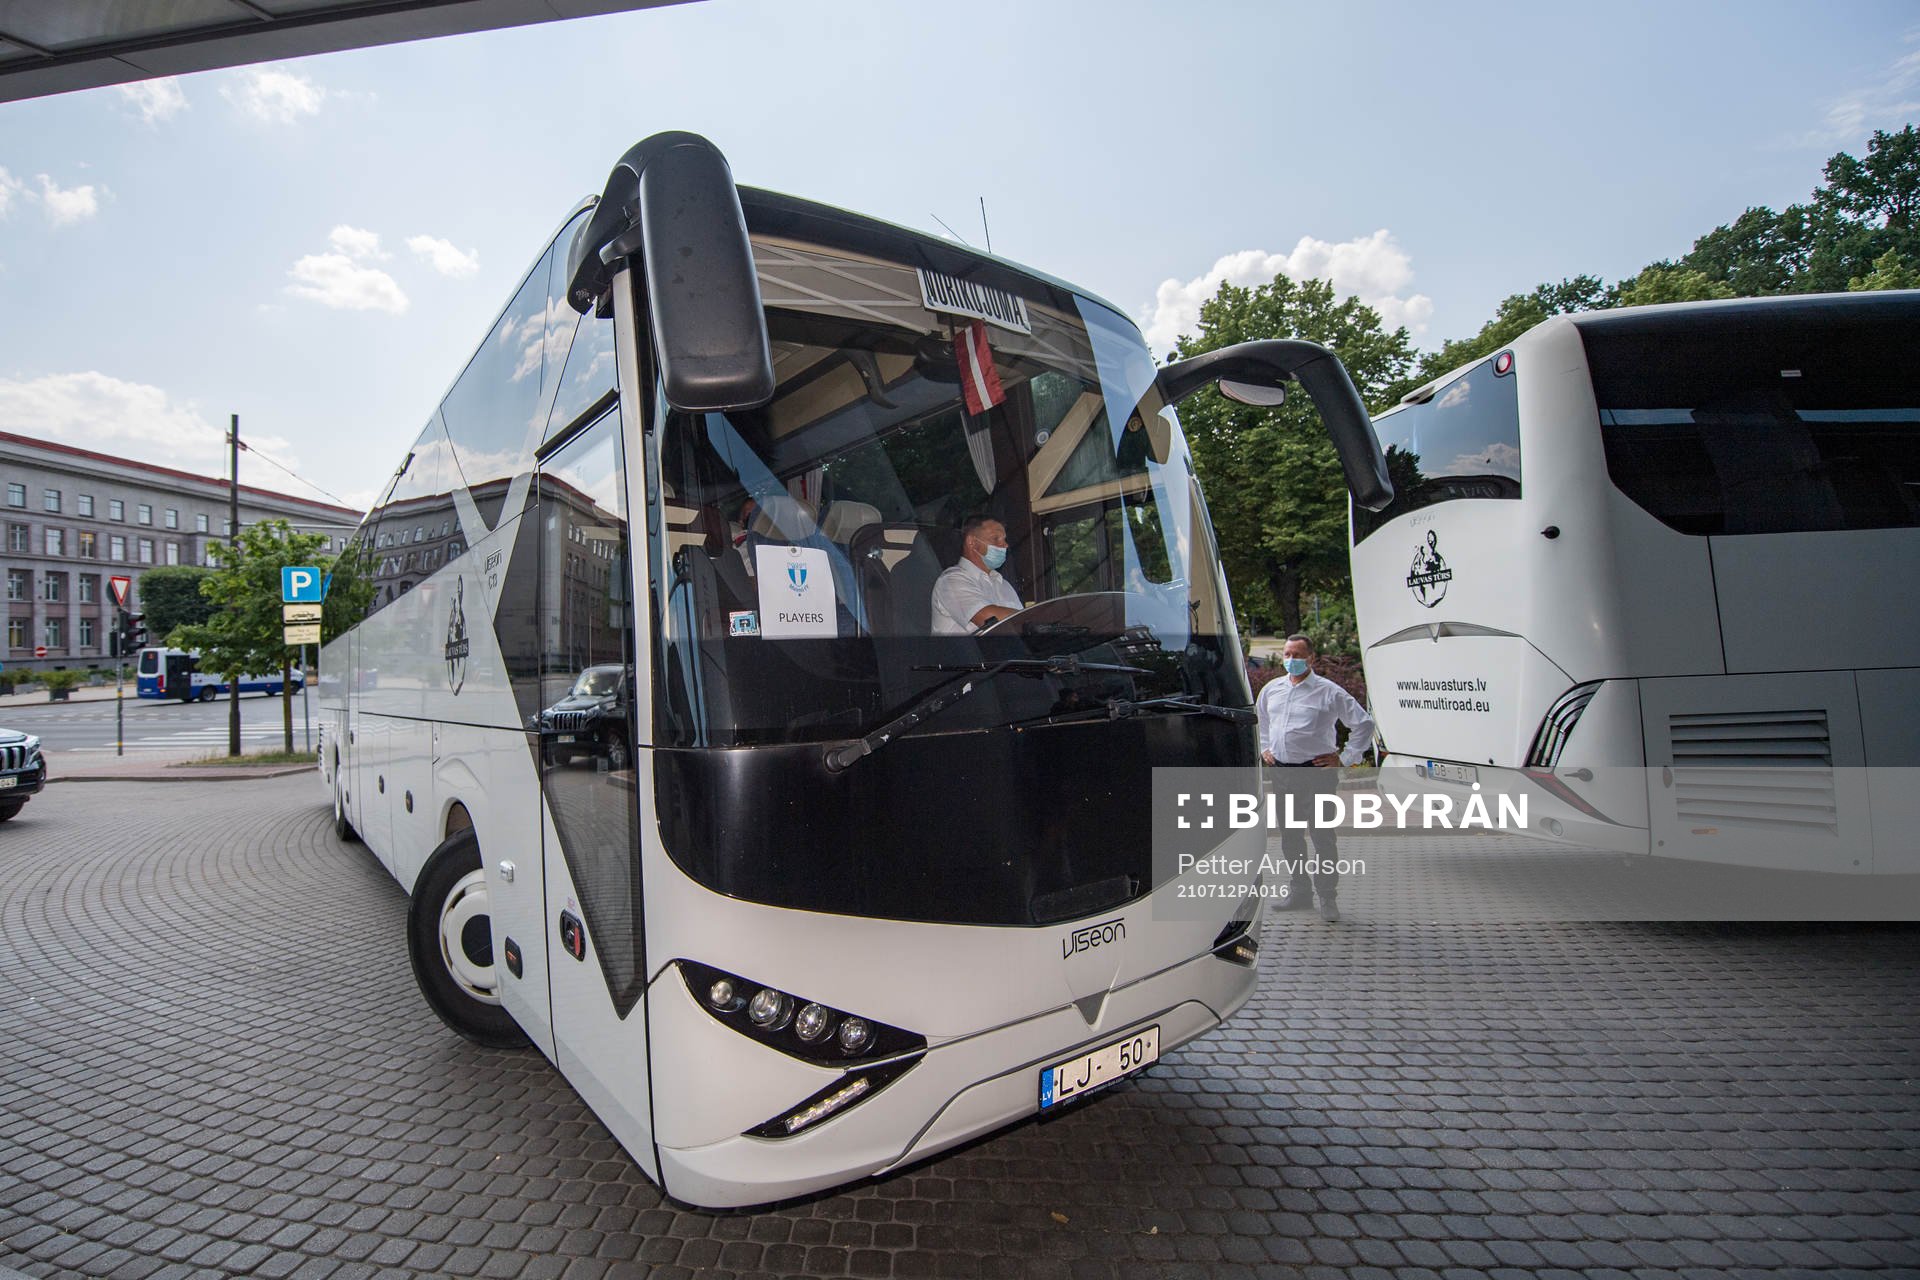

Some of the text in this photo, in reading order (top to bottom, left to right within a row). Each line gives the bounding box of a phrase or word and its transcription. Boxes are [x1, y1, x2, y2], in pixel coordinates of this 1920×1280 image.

[291, 571, 312, 598] P
[779, 612, 824, 623] PLAYERS
[1396, 678, 1487, 692] www.lauvasturs.lv
[1399, 697, 1490, 712] www.multiroad.eu
[1042, 1090, 1052, 1101] LV
